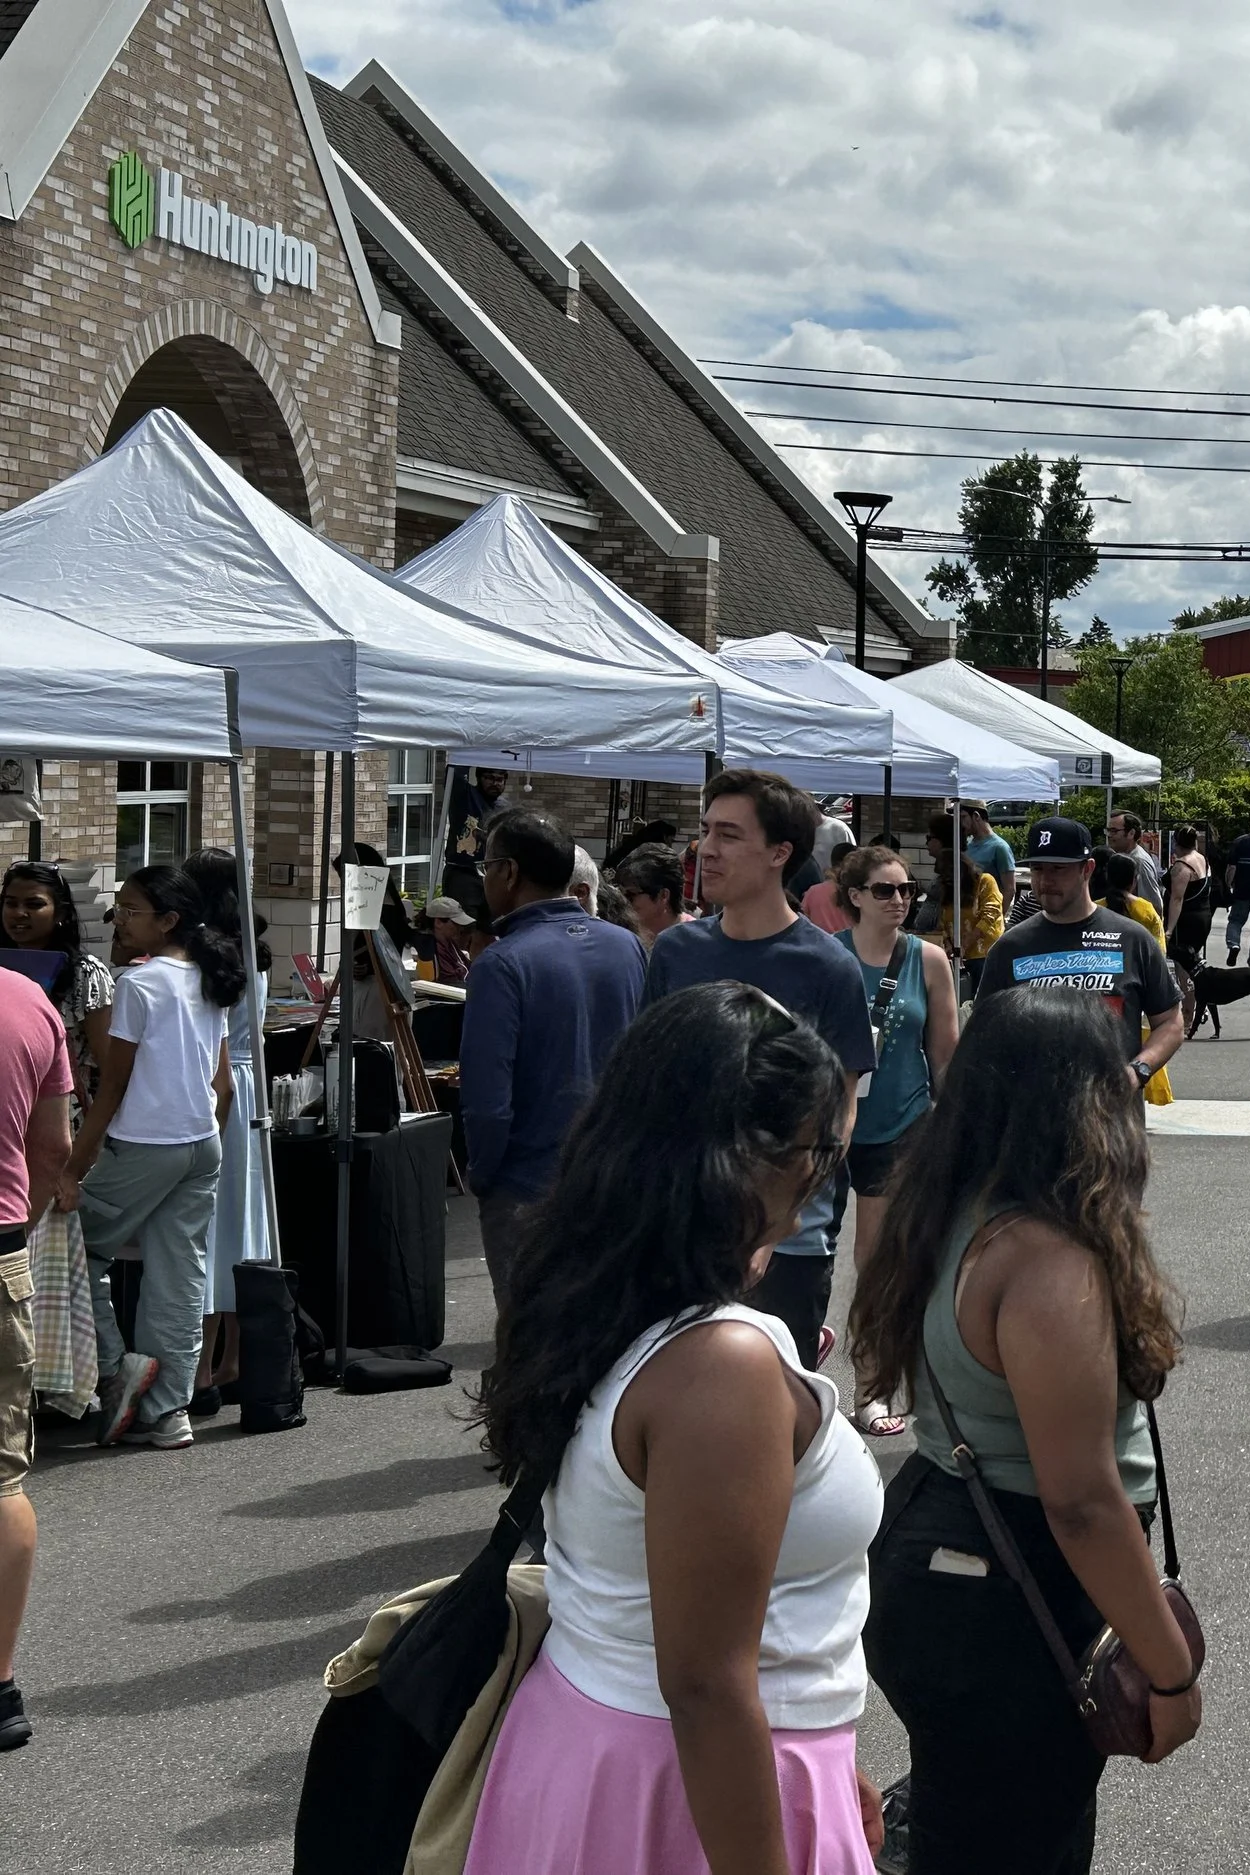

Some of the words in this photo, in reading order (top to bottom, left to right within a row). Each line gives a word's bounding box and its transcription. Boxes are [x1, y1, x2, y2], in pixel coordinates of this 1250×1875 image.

[156, 166, 318, 296] Huntington
[1038, 830, 1052, 848] D
[1016, 958, 1042, 976] Troy
[1043, 956, 1067, 972] Lee
[1084, 973, 1114, 991] OIL
